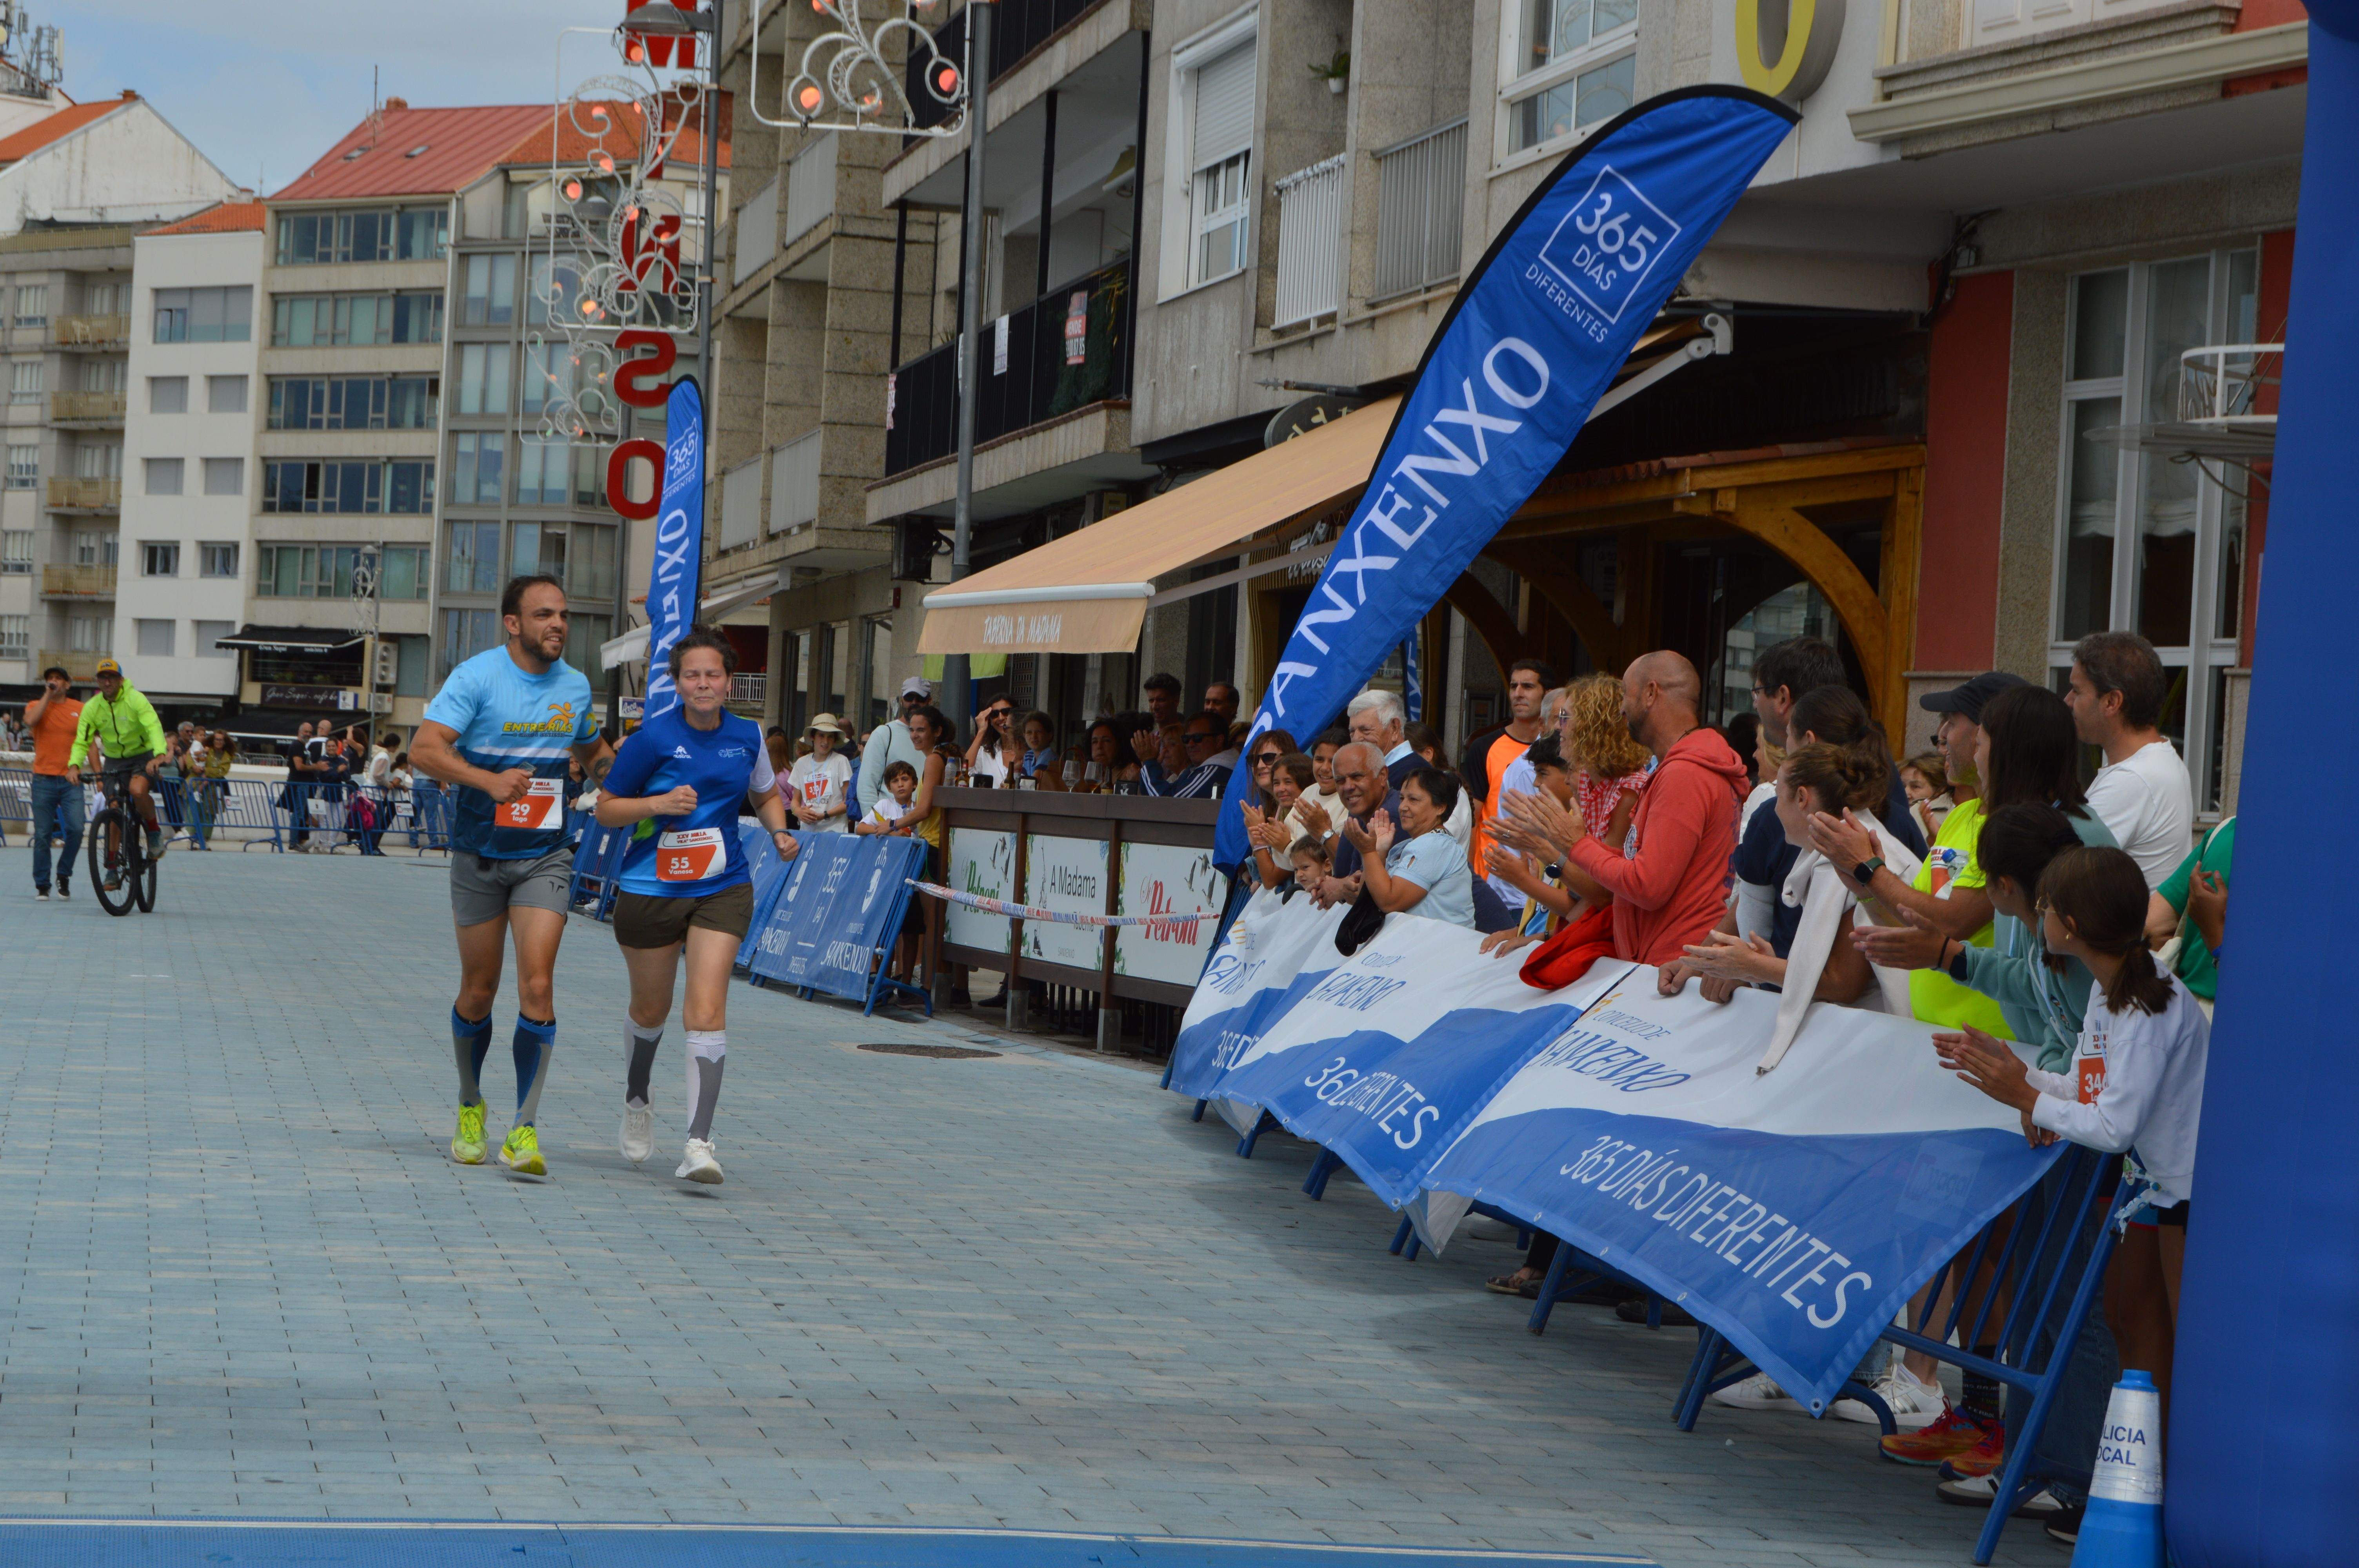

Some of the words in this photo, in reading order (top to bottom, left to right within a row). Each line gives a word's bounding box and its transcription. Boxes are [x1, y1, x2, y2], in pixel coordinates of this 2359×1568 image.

[1576, 192, 1658, 272] 365
[1572, 244, 1617, 290] DÍAS
[1525, 263, 1608, 343] DIFERENTES
[1067, 319, 1082, 336] ENDE
[669, 432, 695, 470] 365
[502, 722, 546, 733] ENTRE
[511, 802, 531, 816] 29
[670, 857, 690, 869] 55
[1059, 865, 1096, 899] Madama
[820, 940, 870, 975] SANXENXO
[1593, 1010, 1648, 1034] CONCELLO
[1639, 1026, 1671, 1041] DE
[1559, 1135, 1637, 1184] 365
[1597, 1149, 1690, 1210] DÍAS
[1652, 1172, 1872, 1329] DIFERENTES
[2101, 1424, 2146, 1446] LICIA
[2096, 1446, 2136, 1466] OCAL
